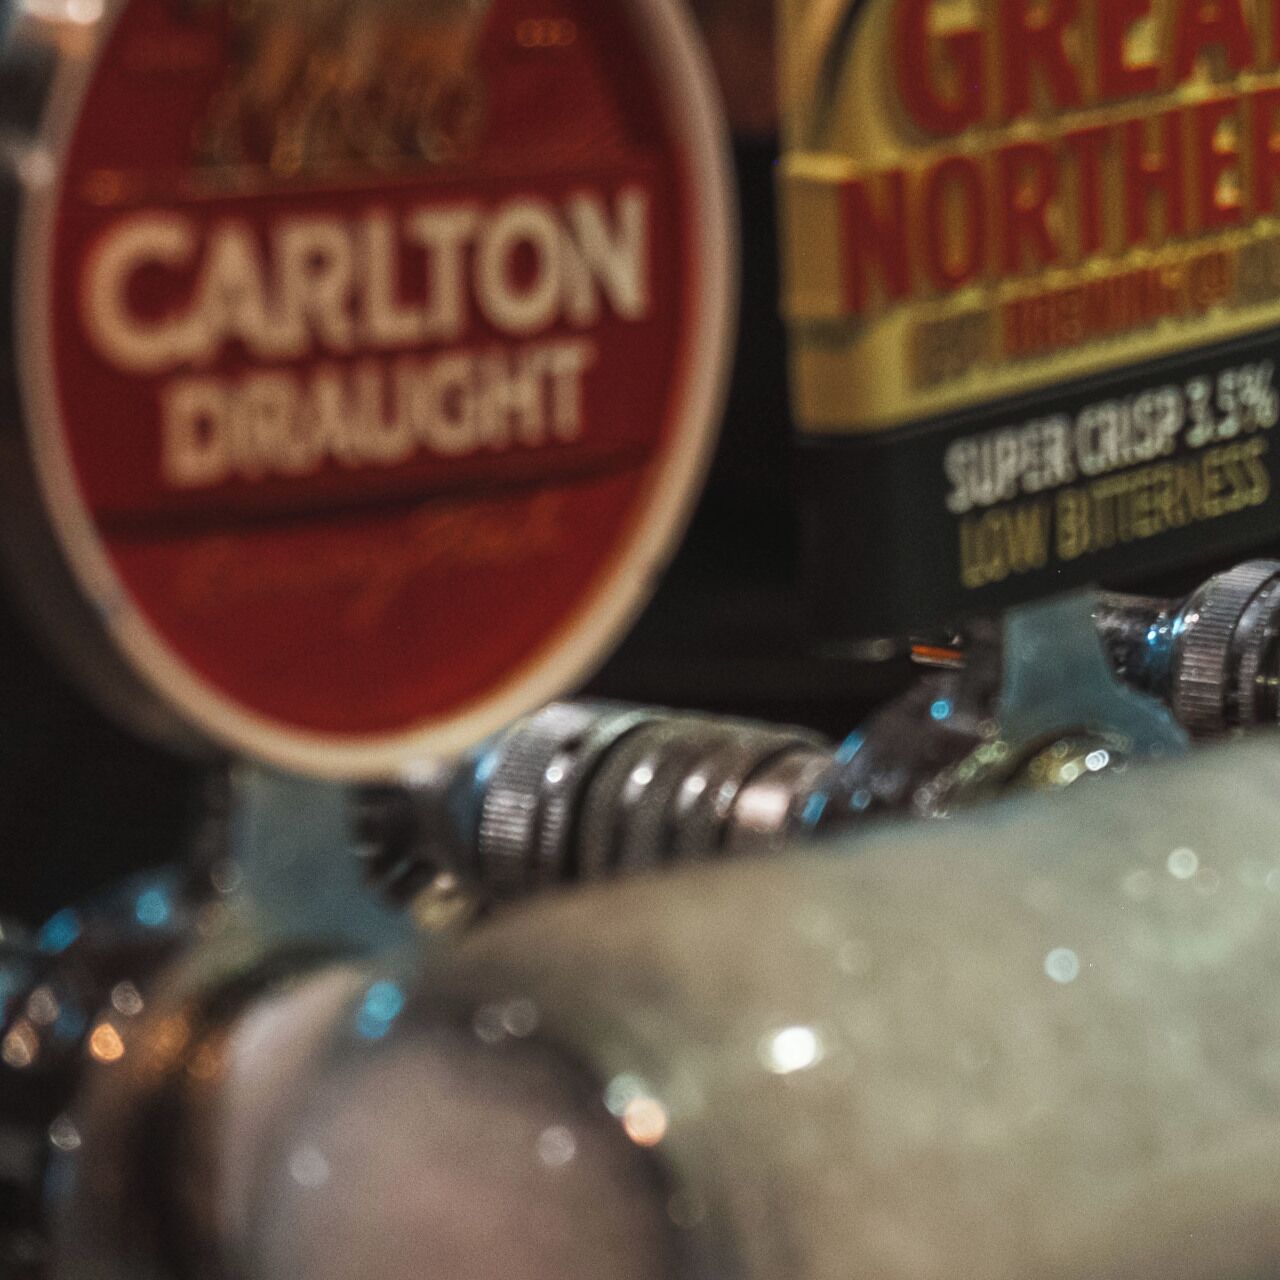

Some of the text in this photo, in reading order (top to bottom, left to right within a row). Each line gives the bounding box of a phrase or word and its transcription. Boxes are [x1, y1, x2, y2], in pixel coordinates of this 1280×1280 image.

[82, 182, 652, 376] CARLTON
[161, 338, 595, 487] DRAUGHT
[944, 358, 1280, 514] SUPER CRISP 3.5%
[959, 436, 1271, 589] LOW BITTERNESS
